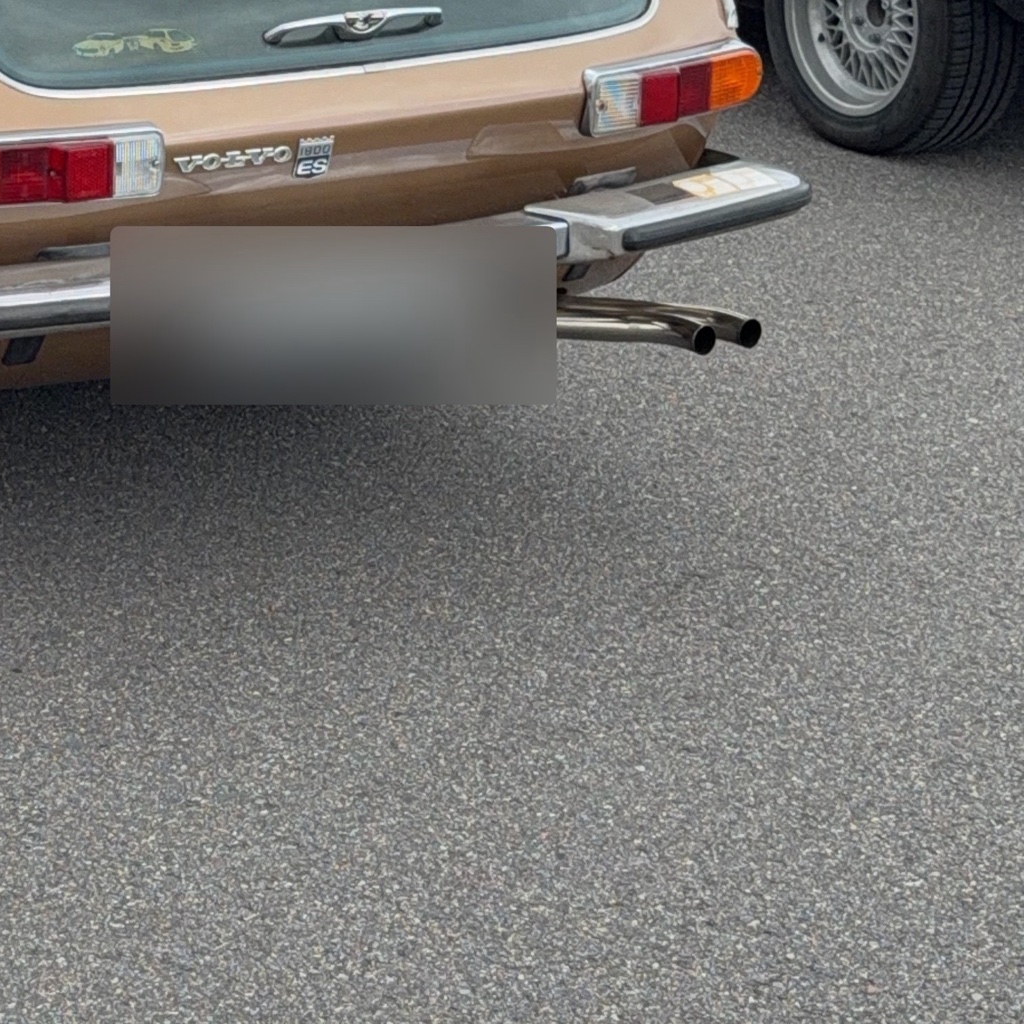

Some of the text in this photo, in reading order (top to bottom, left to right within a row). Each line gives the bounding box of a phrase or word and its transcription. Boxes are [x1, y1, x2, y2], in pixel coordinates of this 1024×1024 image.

[300, 143, 330, 156] 1800
[174, 145, 293, 173] VOLVO
[297, 159, 327, 175] ES
